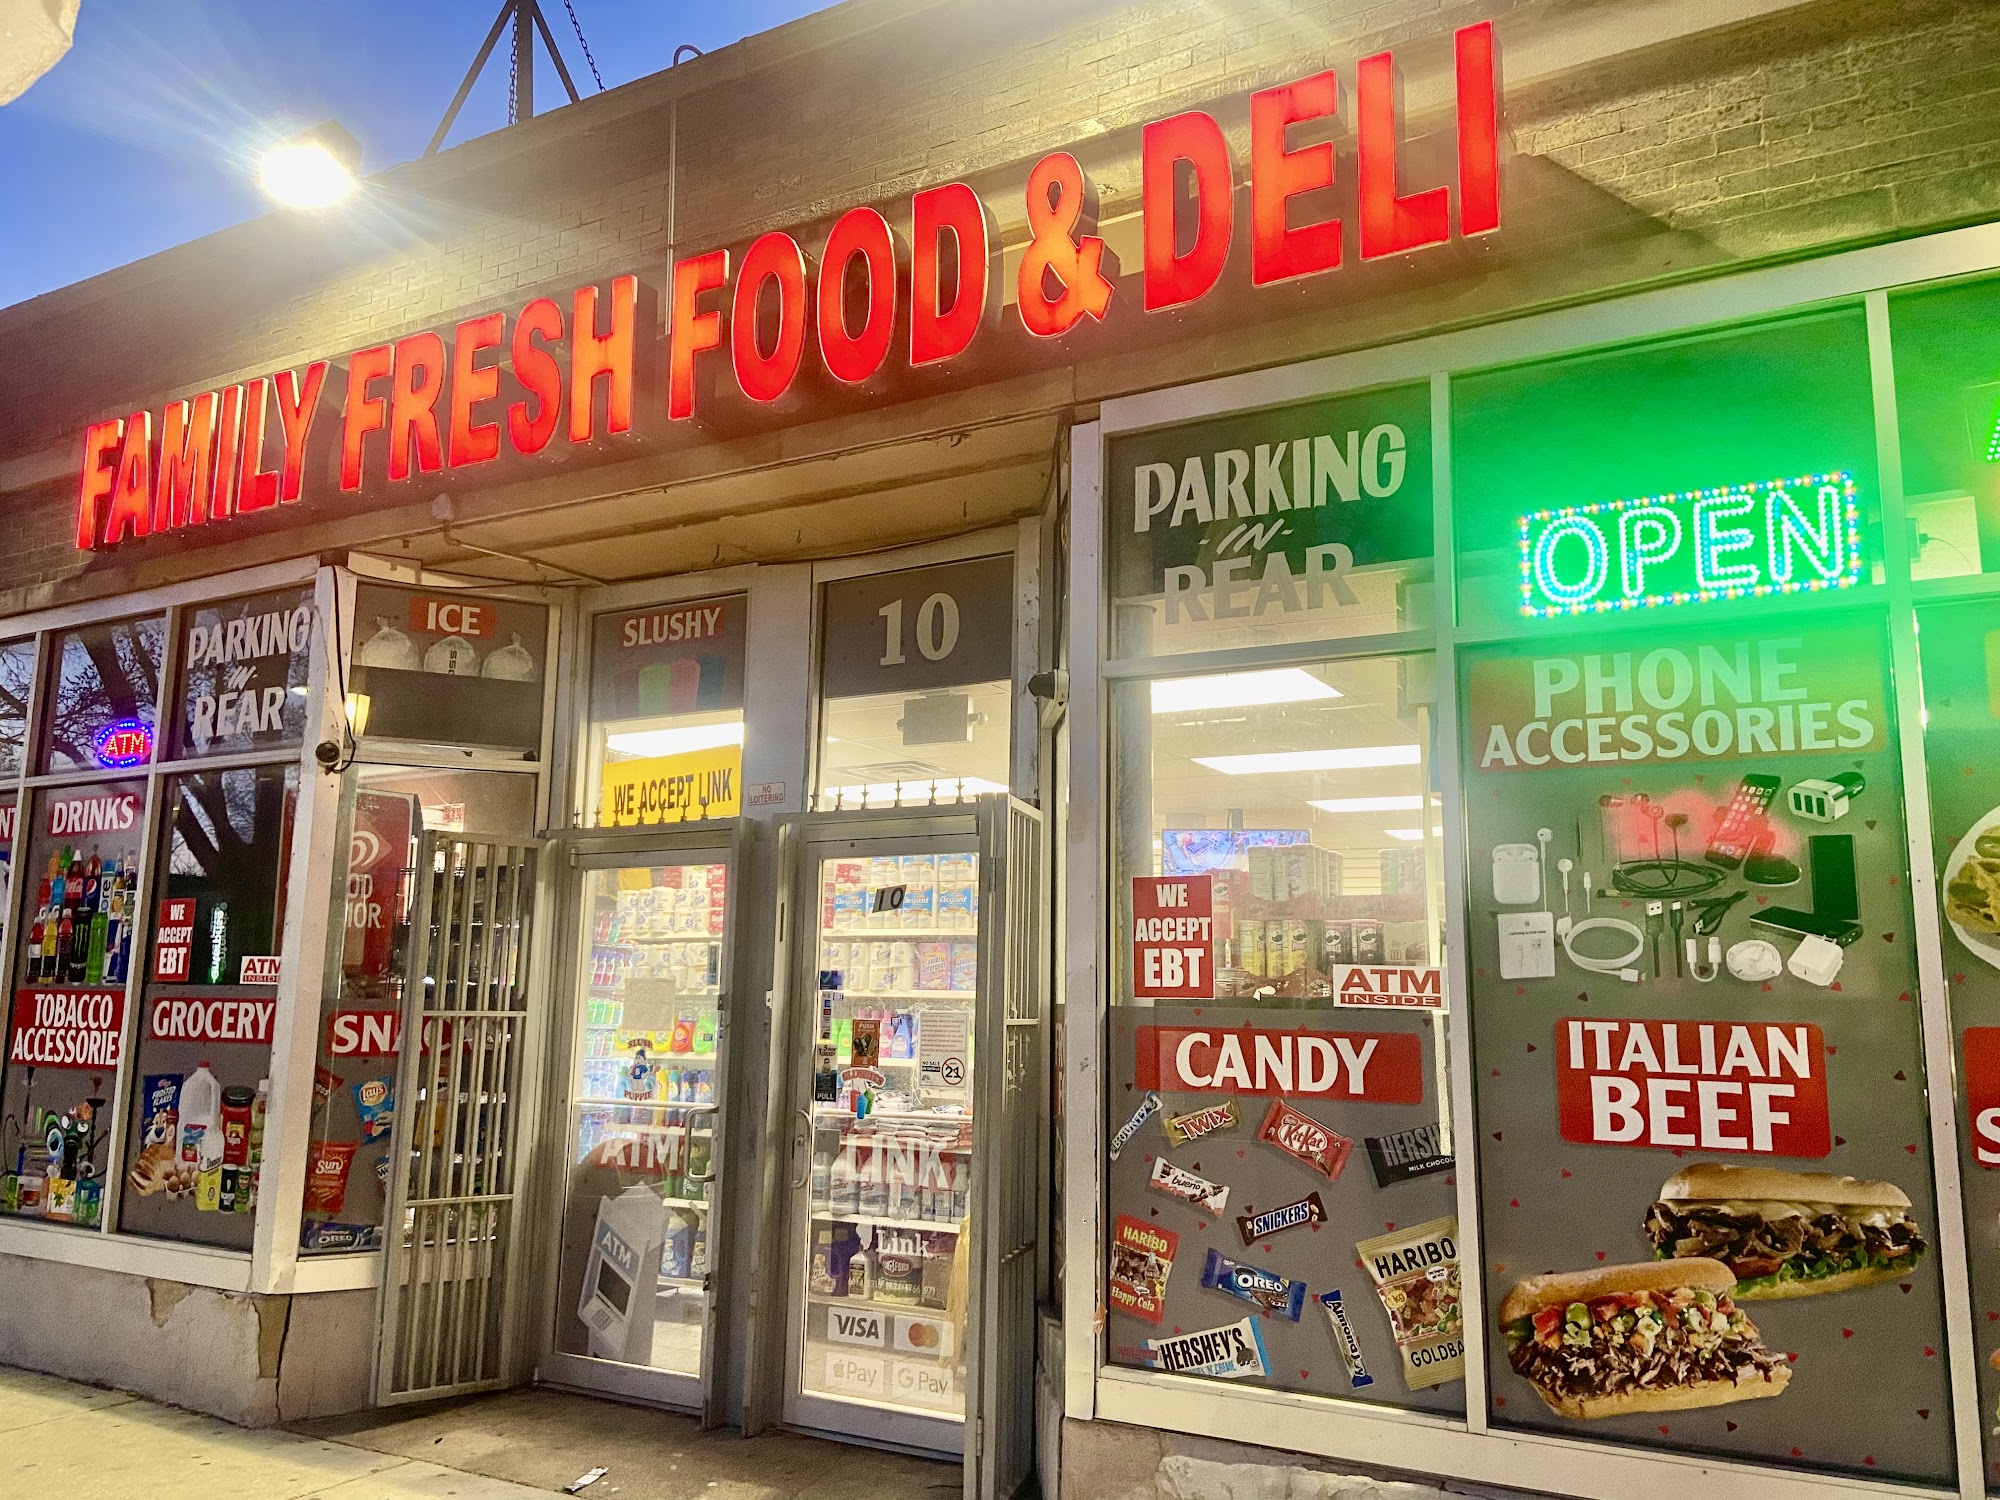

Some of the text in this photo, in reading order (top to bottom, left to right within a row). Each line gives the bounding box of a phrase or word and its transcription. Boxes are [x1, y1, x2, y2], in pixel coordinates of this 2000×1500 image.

[75, 20, 1501, 549] FAMILY FRESH FOOD & DELI
[1134, 424, 1406, 532] PARKING
[1533, 483, 1844, 605] OPEN
[1163, 543, 1360, 625] REAR
[427, 601, 481, 635] ICE
[622, 606, 722, 648] SLUSHY
[878, 592, 960, 667] 10
[187, 607, 313, 669] PARKING
[1533, 637, 1808, 718] PHONE
[193, 686, 286, 738] REAR
[104, 732, 146, 757] ATM
[1480, 700, 1874, 768] ACCESSORIES
[614, 768, 733, 816] WE ACCEPT LINK
[750, 792, 784, 804] LOITERING
[762, 784, 772, 794] NO
[51, 795, 136, 834] DRINKS
[877, 886, 905, 911] 10
[1156, 883, 1189, 908] WE
[170, 904, 185, 920] WE
[158, 926, 193, 944] ACCEPT
[1135, 916, 1211, 942] ACCEPT
[158, 947, 188, 974] EBT
[1144, 947, 1205, 988] EBT
[243, 975, 279, 983] INSID
[1340, 968, 1441, 994] ATM
[34, 993, 113, 1029] TOBACCO
[1344, 994, 1435, 1006] INSIDE
[153, 999, 274, 1040] GROCERY
[11, 1026, 120, 1066] ACCESSORIE
[627, 1038, 653, 1050] SLUSH
[1567, 1020, 1811, 1079] ITALIAN
[945, 1066, 962, 1078] 21
[1175, 1031, 1379, 1095] CANDY
[152, 1085, 177, 1100] FROSTED
[153, 1095, 173, 1107] FLAKES
[624, 1090, 653, 1101] PUPPIE
[817, 1092, 834, 1100] PULL
[1112, 1105, 1149, 1149] BOUNTY
[1590, 1075, 1796, 1152] BEEF
[600, 1133, 679, 1170] ATM
[846, 1133, 950, 1189] LINK
[1408, 1163, 1425, 1172] MILK
[1171, 1175, 1201, 1190] bueno
[1255, 1202, 1309, 1235] SNICKERS
[602, 1231, 632, 1269] ATM
[875, 1229, 929, 1258] Link
[1123, 1226, 1168, 1253] HARIBO
[1374, 1237, 1457, 1279] HARIBO
[1111, 1286, 1155, 1312] Happy Cola
[1237, 1274, 1283, 1293] OREO
[833, 1313, 880, 1340] VISA
[1326, 1301, 1360, 1356] Almond
[1158, 1327, 1246, 1371] HERSHEY'S
[1410, 1336, 1464, 1367] GOLDBÄ
[846, 1361, 877, 1388] Pay
[918, 1370, 949, 1396] Pay
